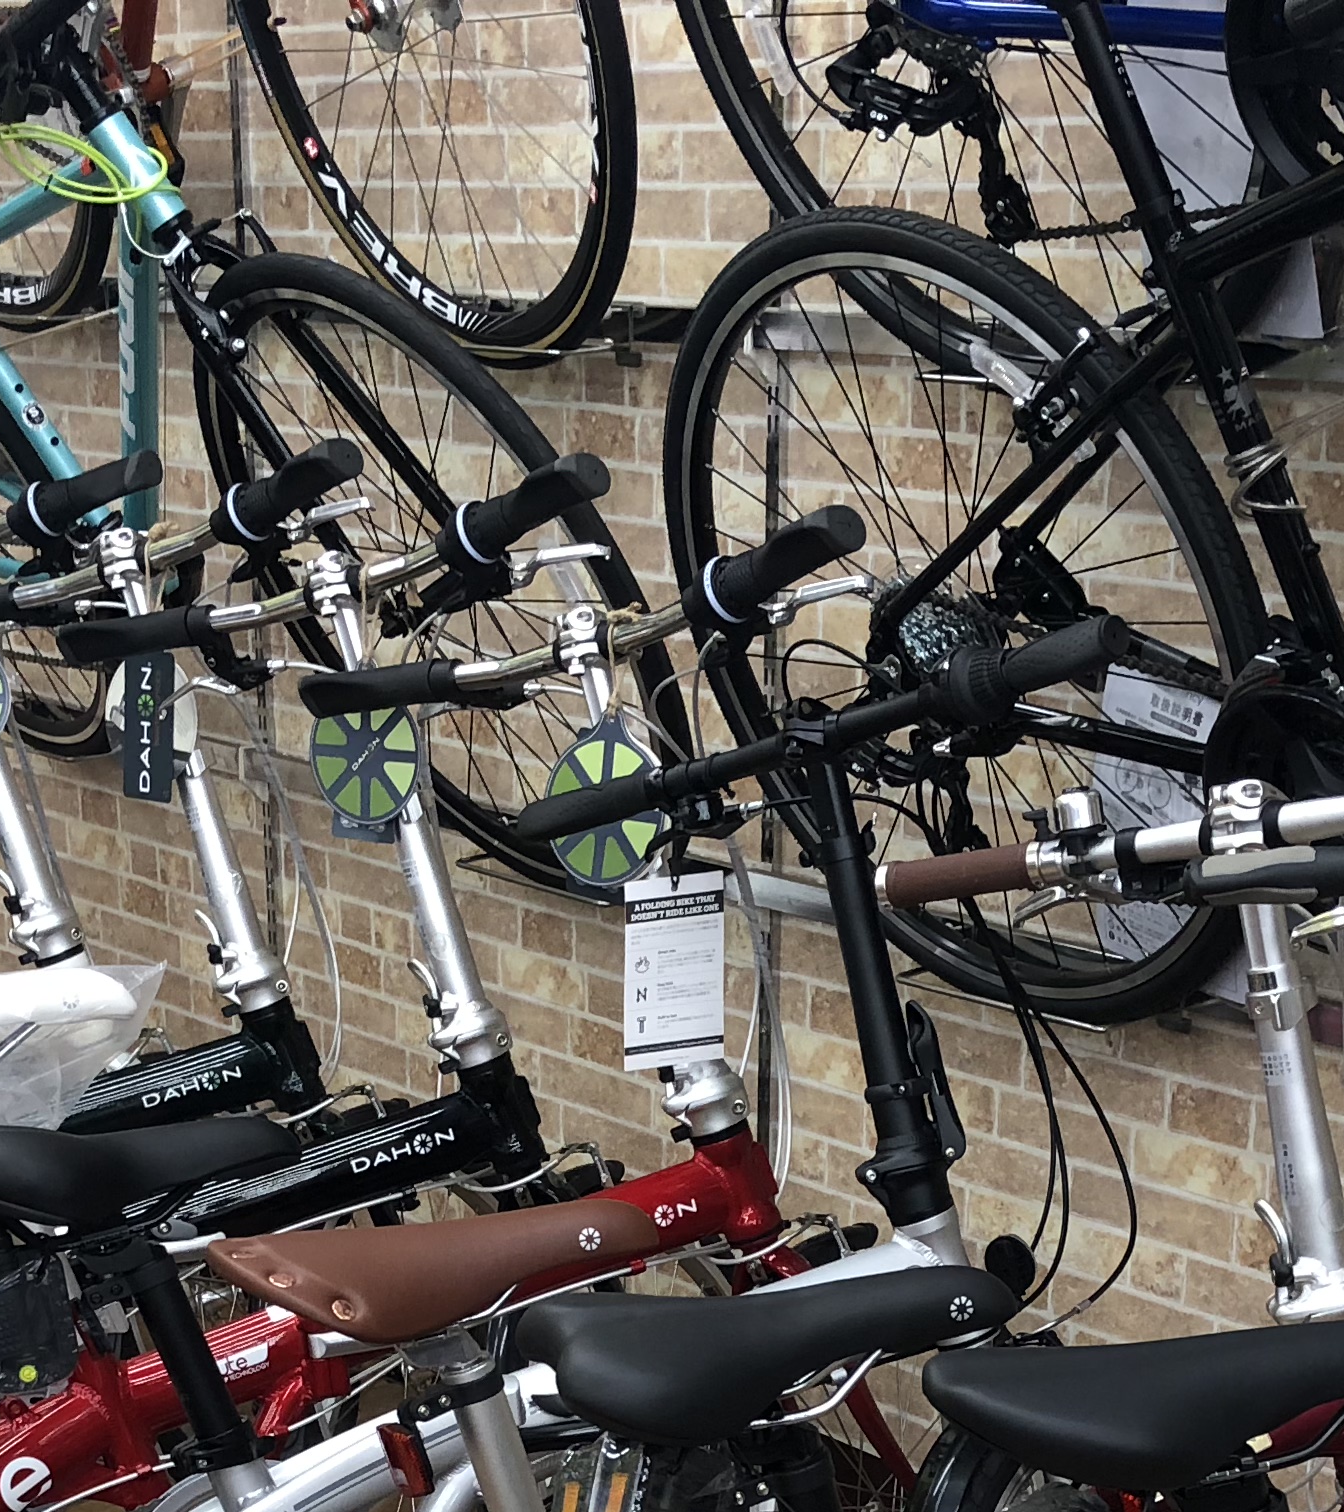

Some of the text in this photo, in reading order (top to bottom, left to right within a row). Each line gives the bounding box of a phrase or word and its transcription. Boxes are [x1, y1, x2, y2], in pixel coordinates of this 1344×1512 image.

[138, 661, 153, 795] DAHON
[350, 735, 382, 772] DAHON
[142, 1064, 242, 1109] DAHON
[351, 1127, 455, 1174] DAHON
[223, 1356, 248, 1376] ute
